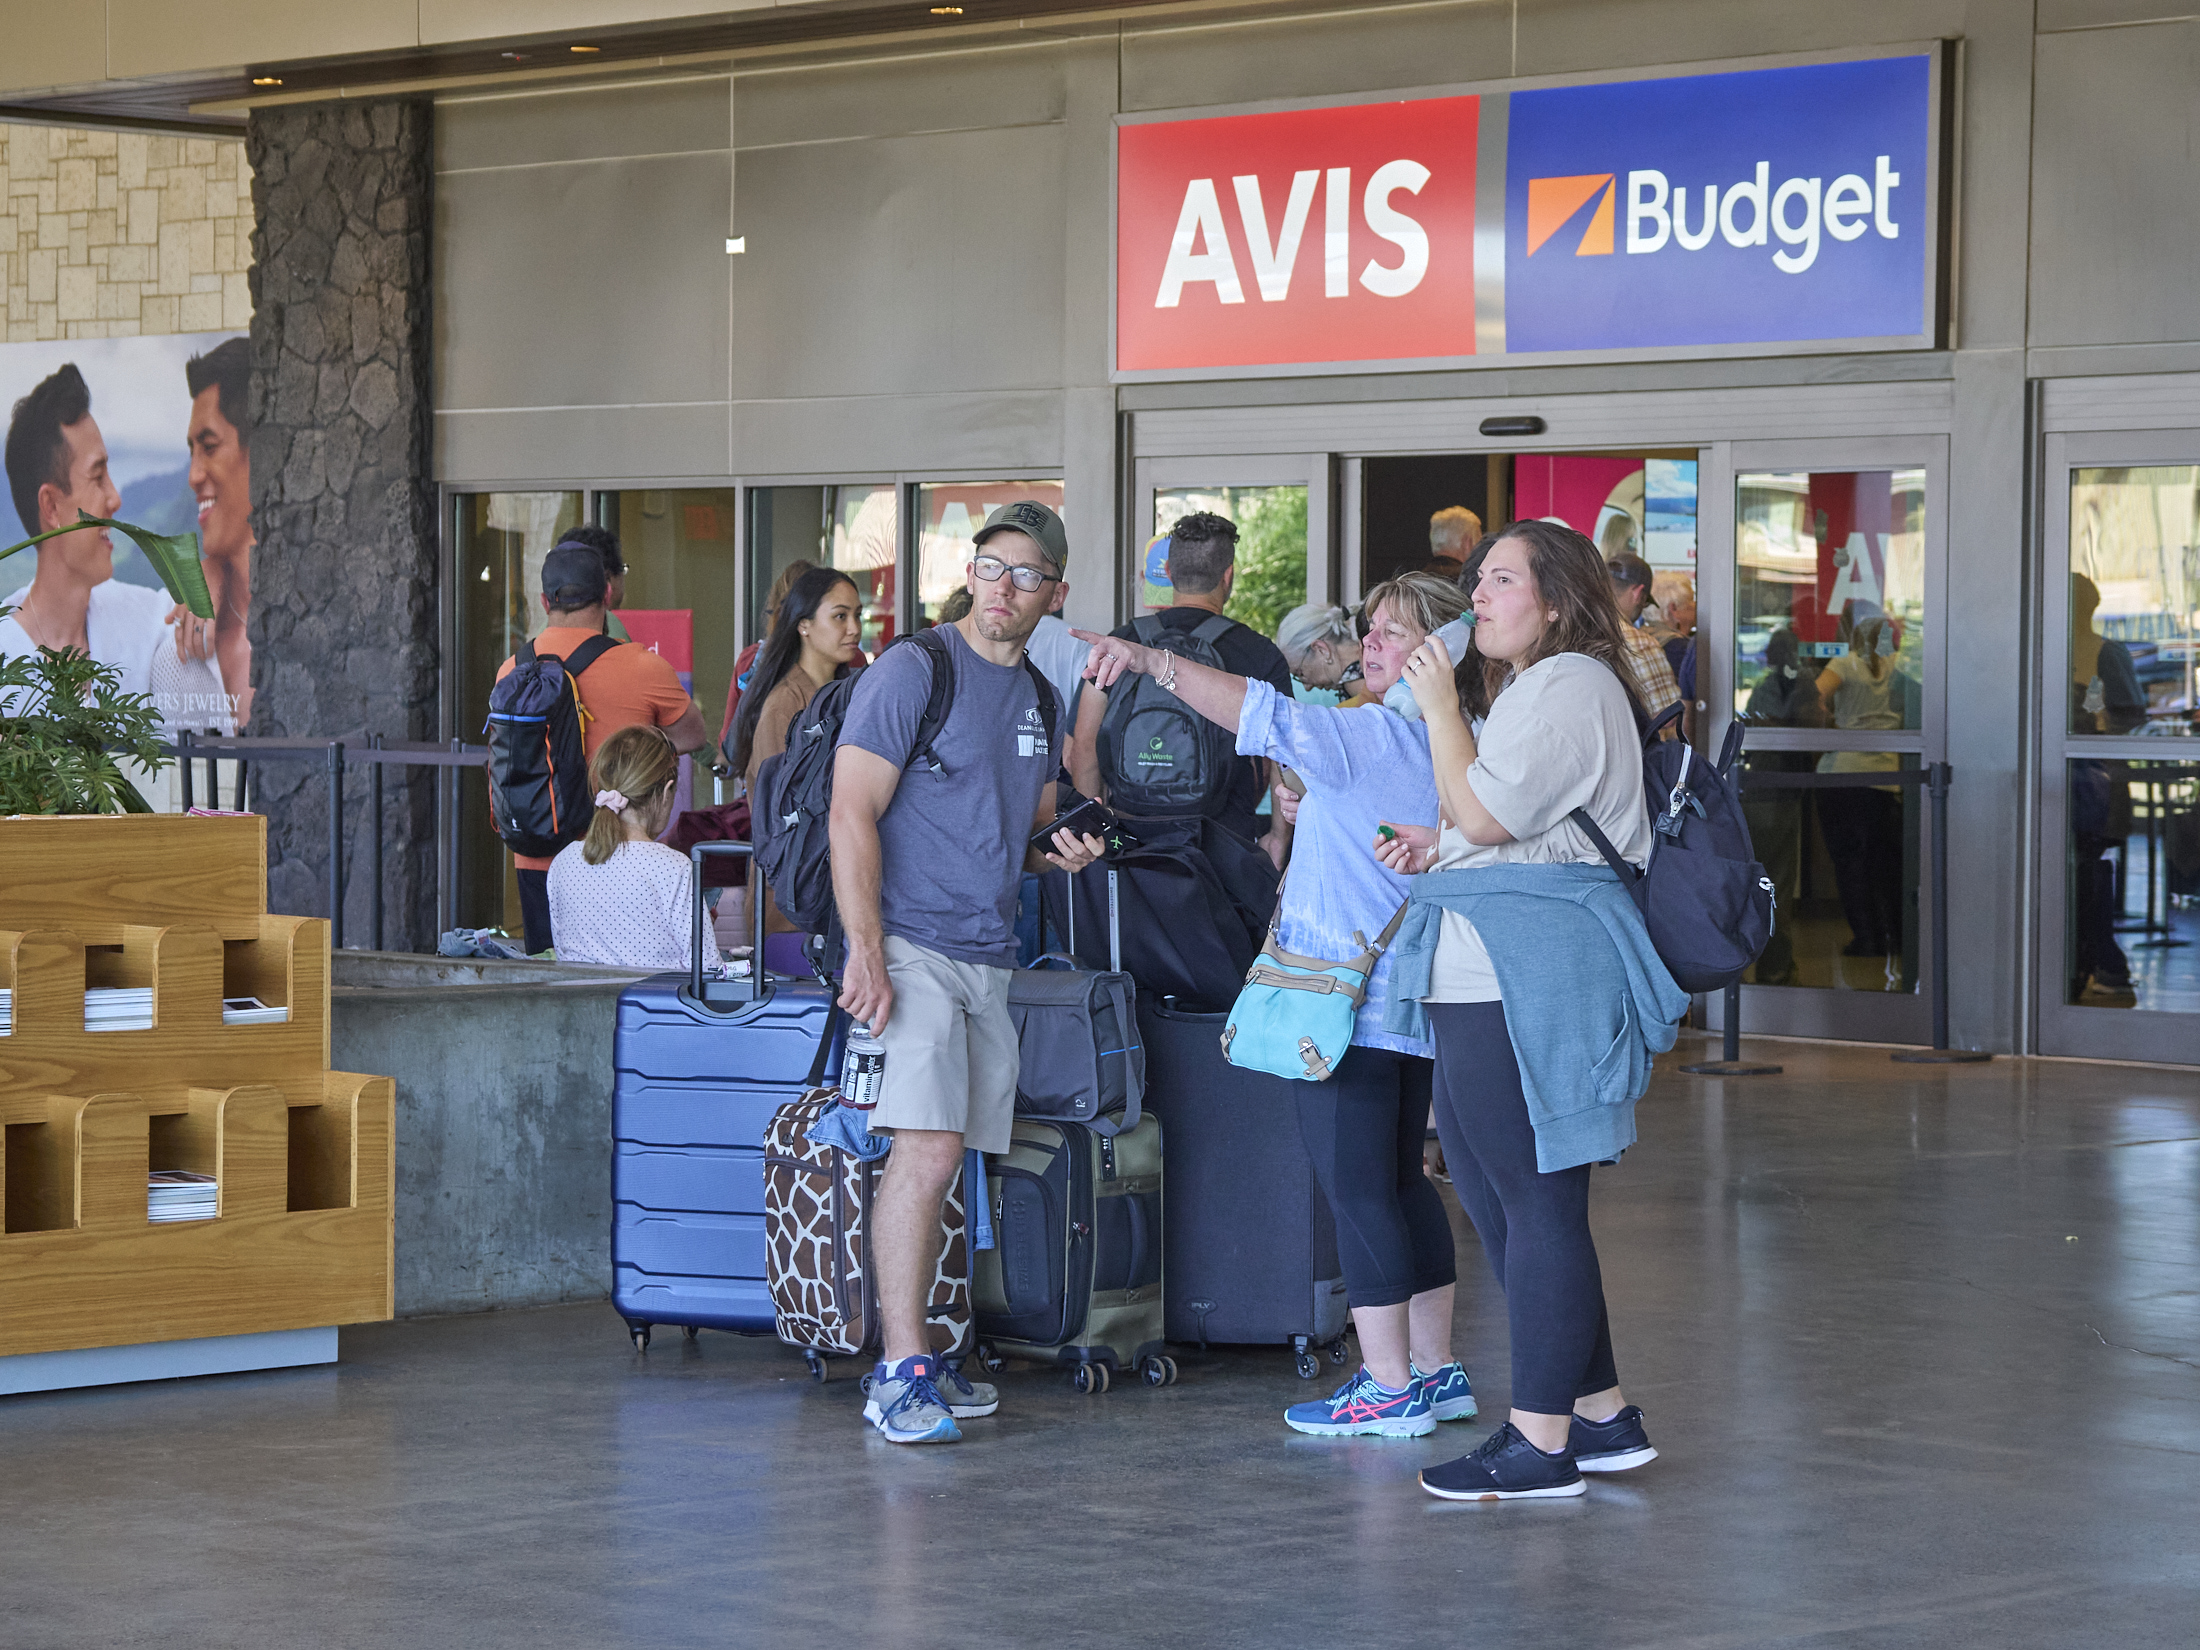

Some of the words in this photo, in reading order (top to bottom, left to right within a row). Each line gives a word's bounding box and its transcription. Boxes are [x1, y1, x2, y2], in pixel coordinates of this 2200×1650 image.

[1154, 159, 1432, 309] AVIS
[1626, 155, 1900, 274] Budget
[182, 693, 241, 714] JEWELRY
[1138, 752, 1152, 761] Ally
[1152, 752, 1173, 761] Waste
[863, 1055, 876, 1103] vitaminwater
